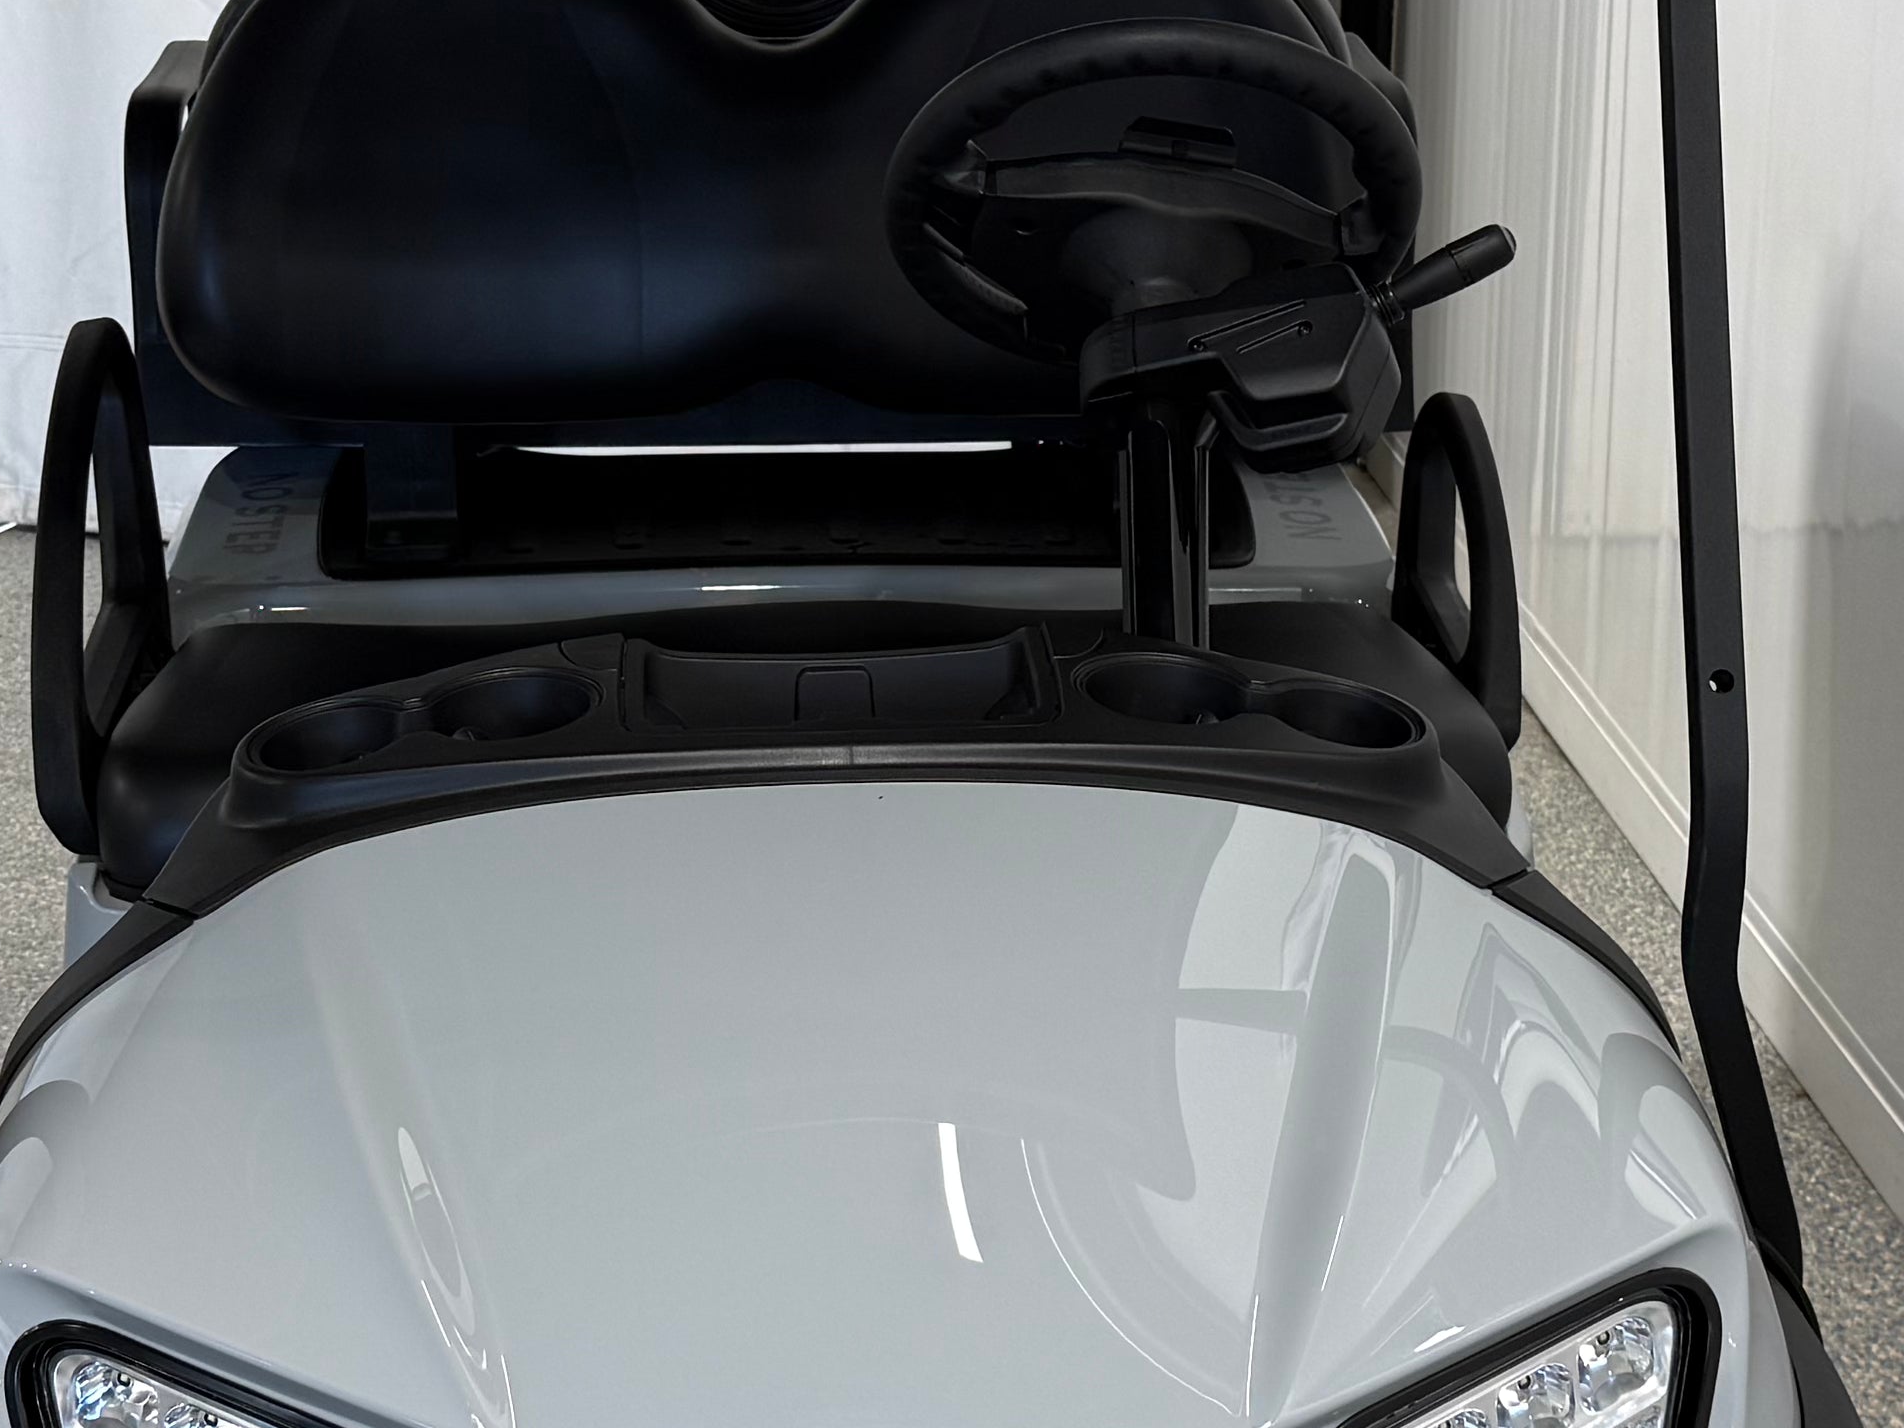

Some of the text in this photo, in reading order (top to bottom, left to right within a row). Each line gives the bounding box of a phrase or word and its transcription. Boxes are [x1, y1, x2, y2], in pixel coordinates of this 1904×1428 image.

[223, 471, 301, 554] NO STEP
[1280, 510, 1343, 541] NO
